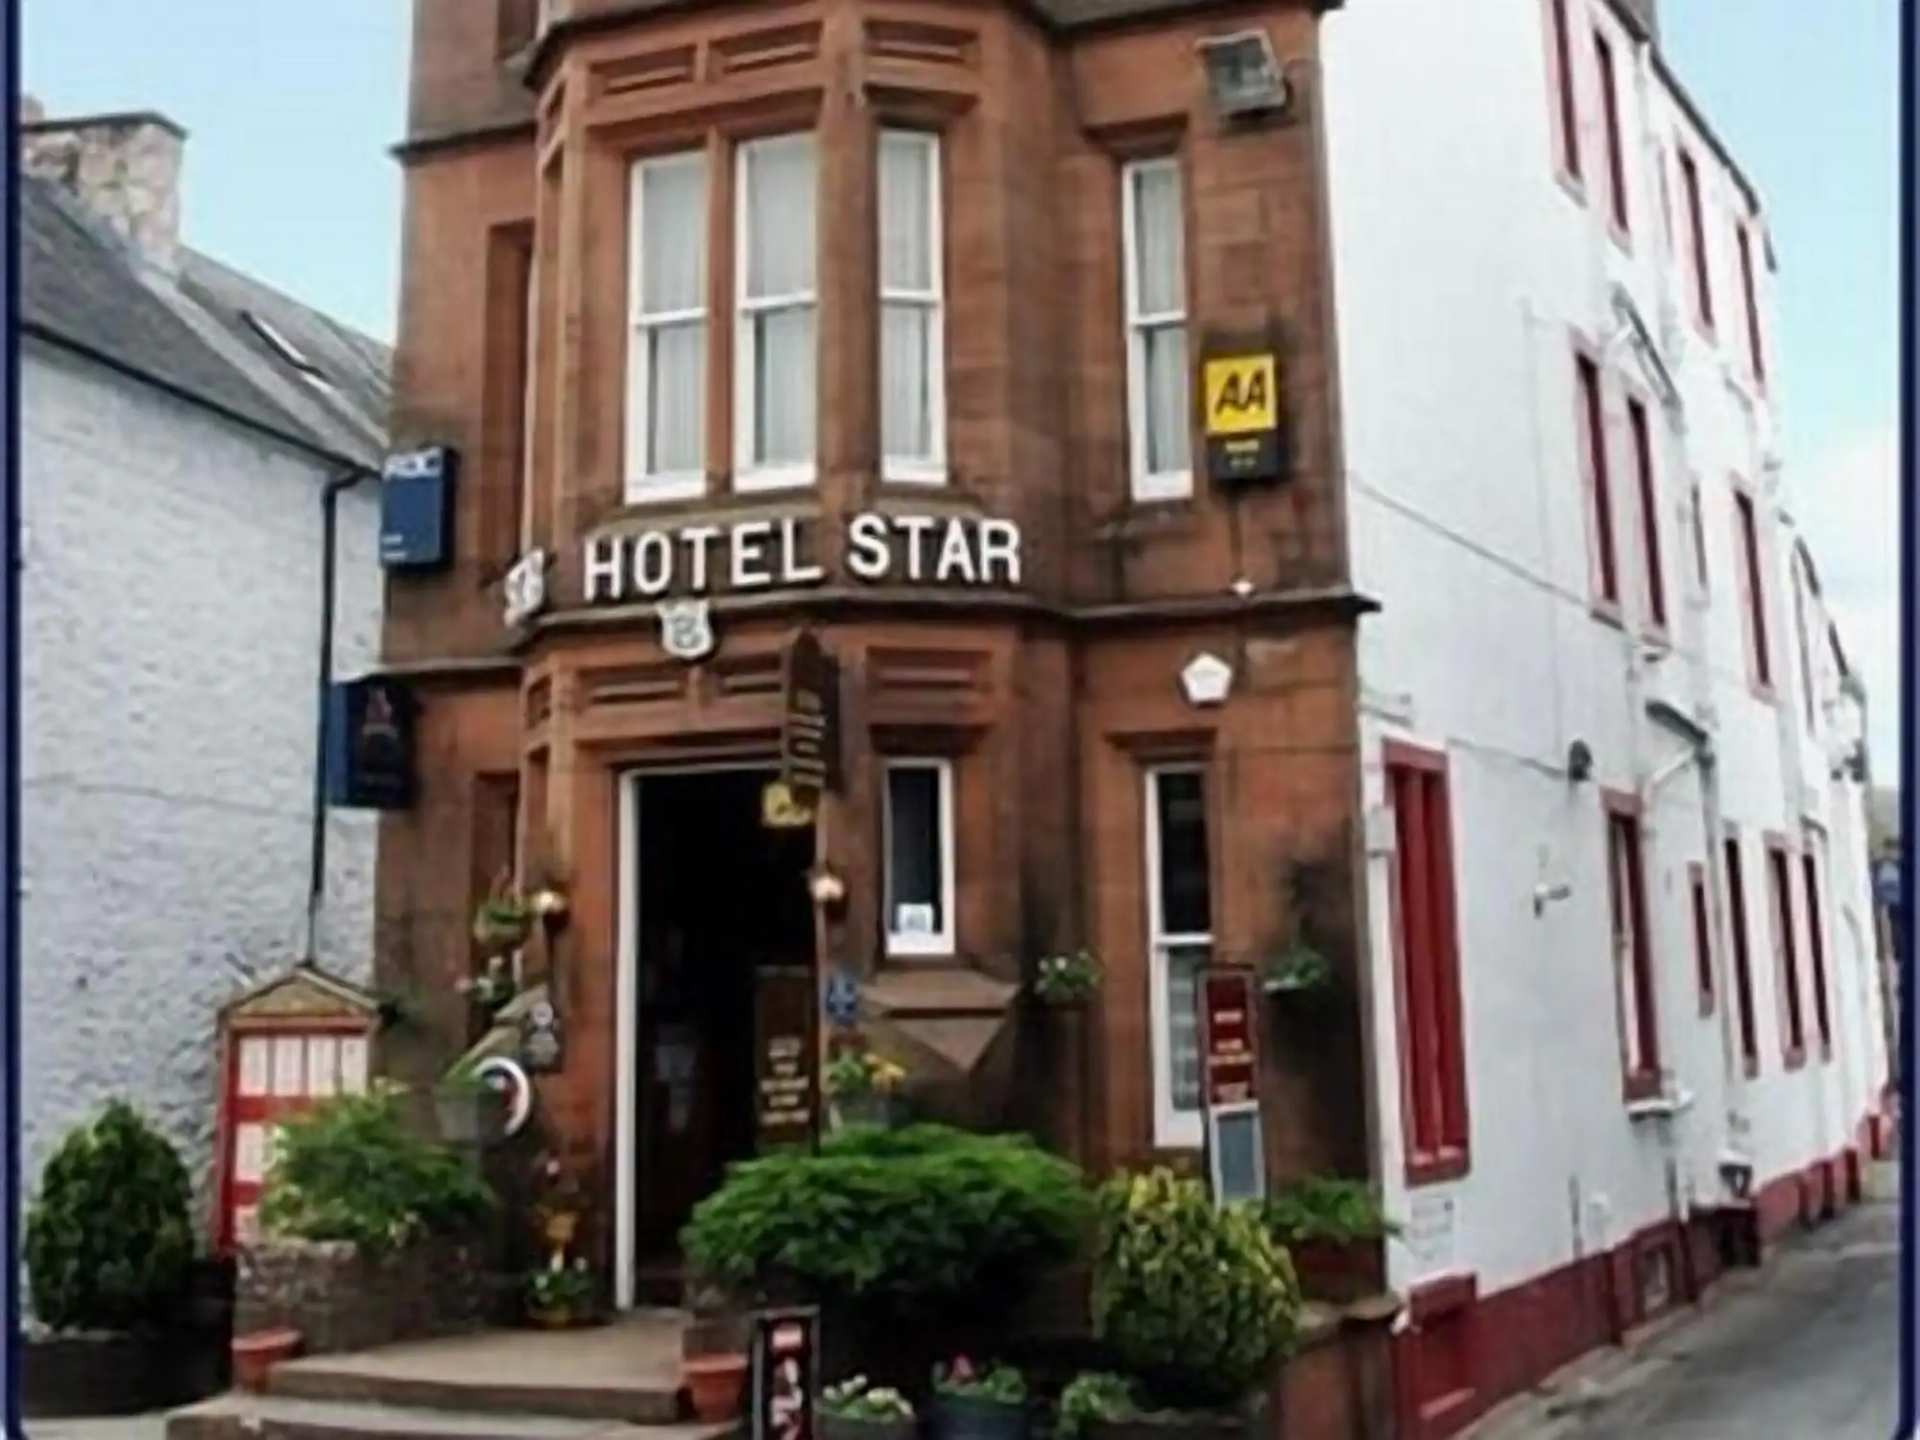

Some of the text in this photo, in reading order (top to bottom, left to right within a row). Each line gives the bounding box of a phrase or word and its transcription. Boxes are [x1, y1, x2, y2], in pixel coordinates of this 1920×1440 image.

[1214, 369, 1266, 415] AA
[583, 517, 824, 601] HOTEL
[848, 513, 1022, 584] STAR
